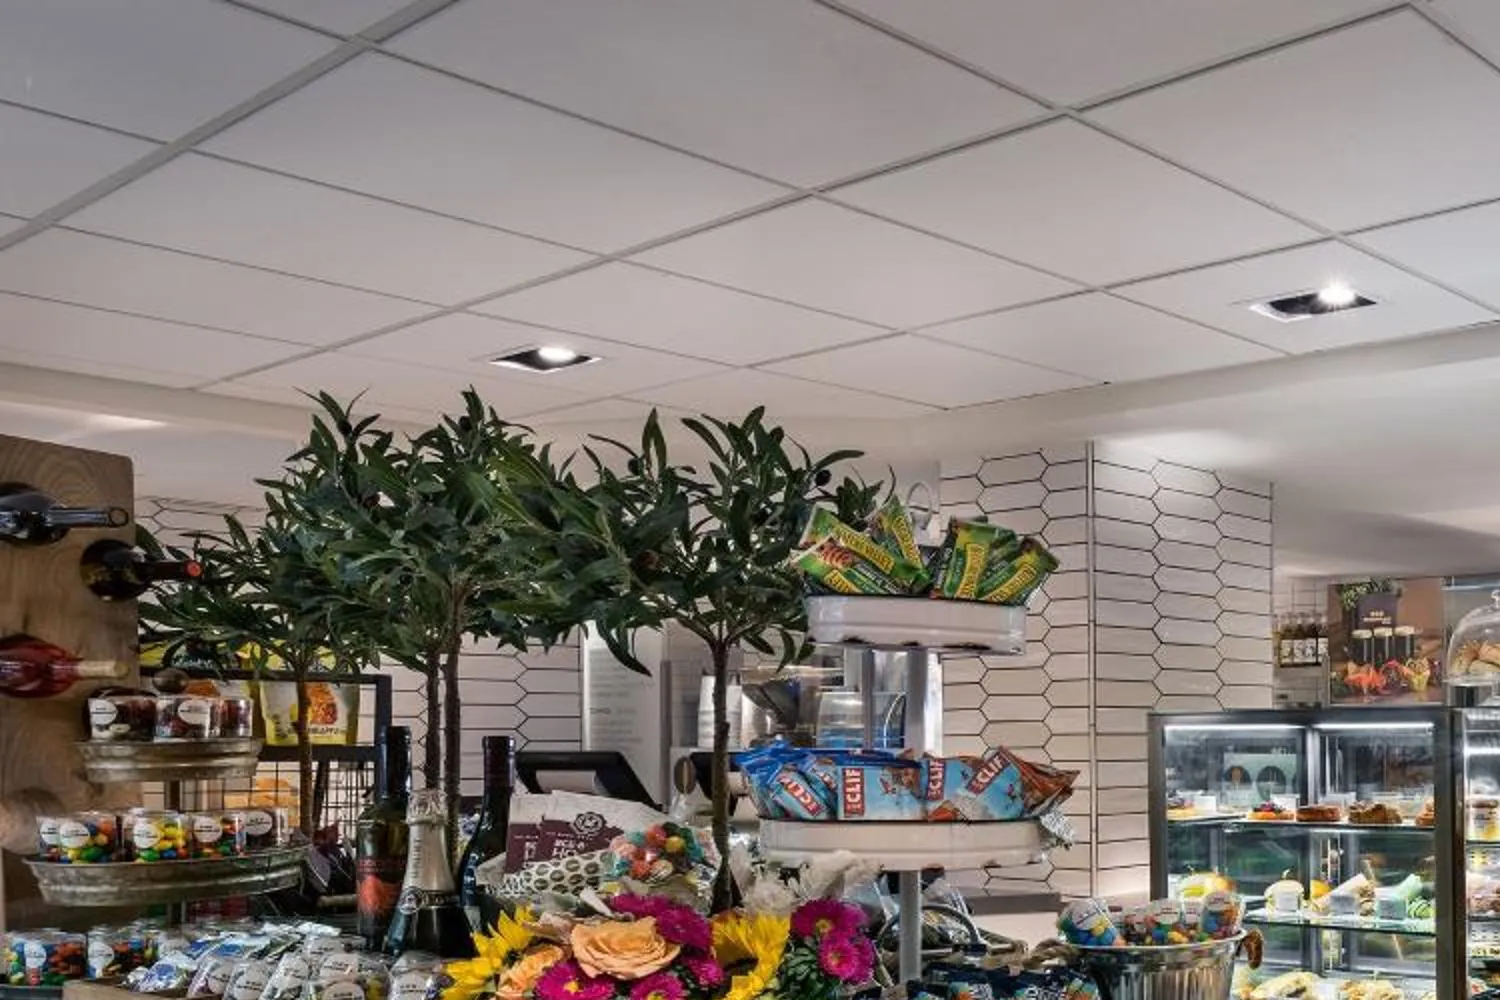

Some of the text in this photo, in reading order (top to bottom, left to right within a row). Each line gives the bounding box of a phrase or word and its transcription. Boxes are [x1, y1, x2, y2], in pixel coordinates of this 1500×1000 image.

[929, 760, 945, 790] CLIF
[975, 753, 1004, 784] CLIF
[846, 768, 862, 803] CLIF
